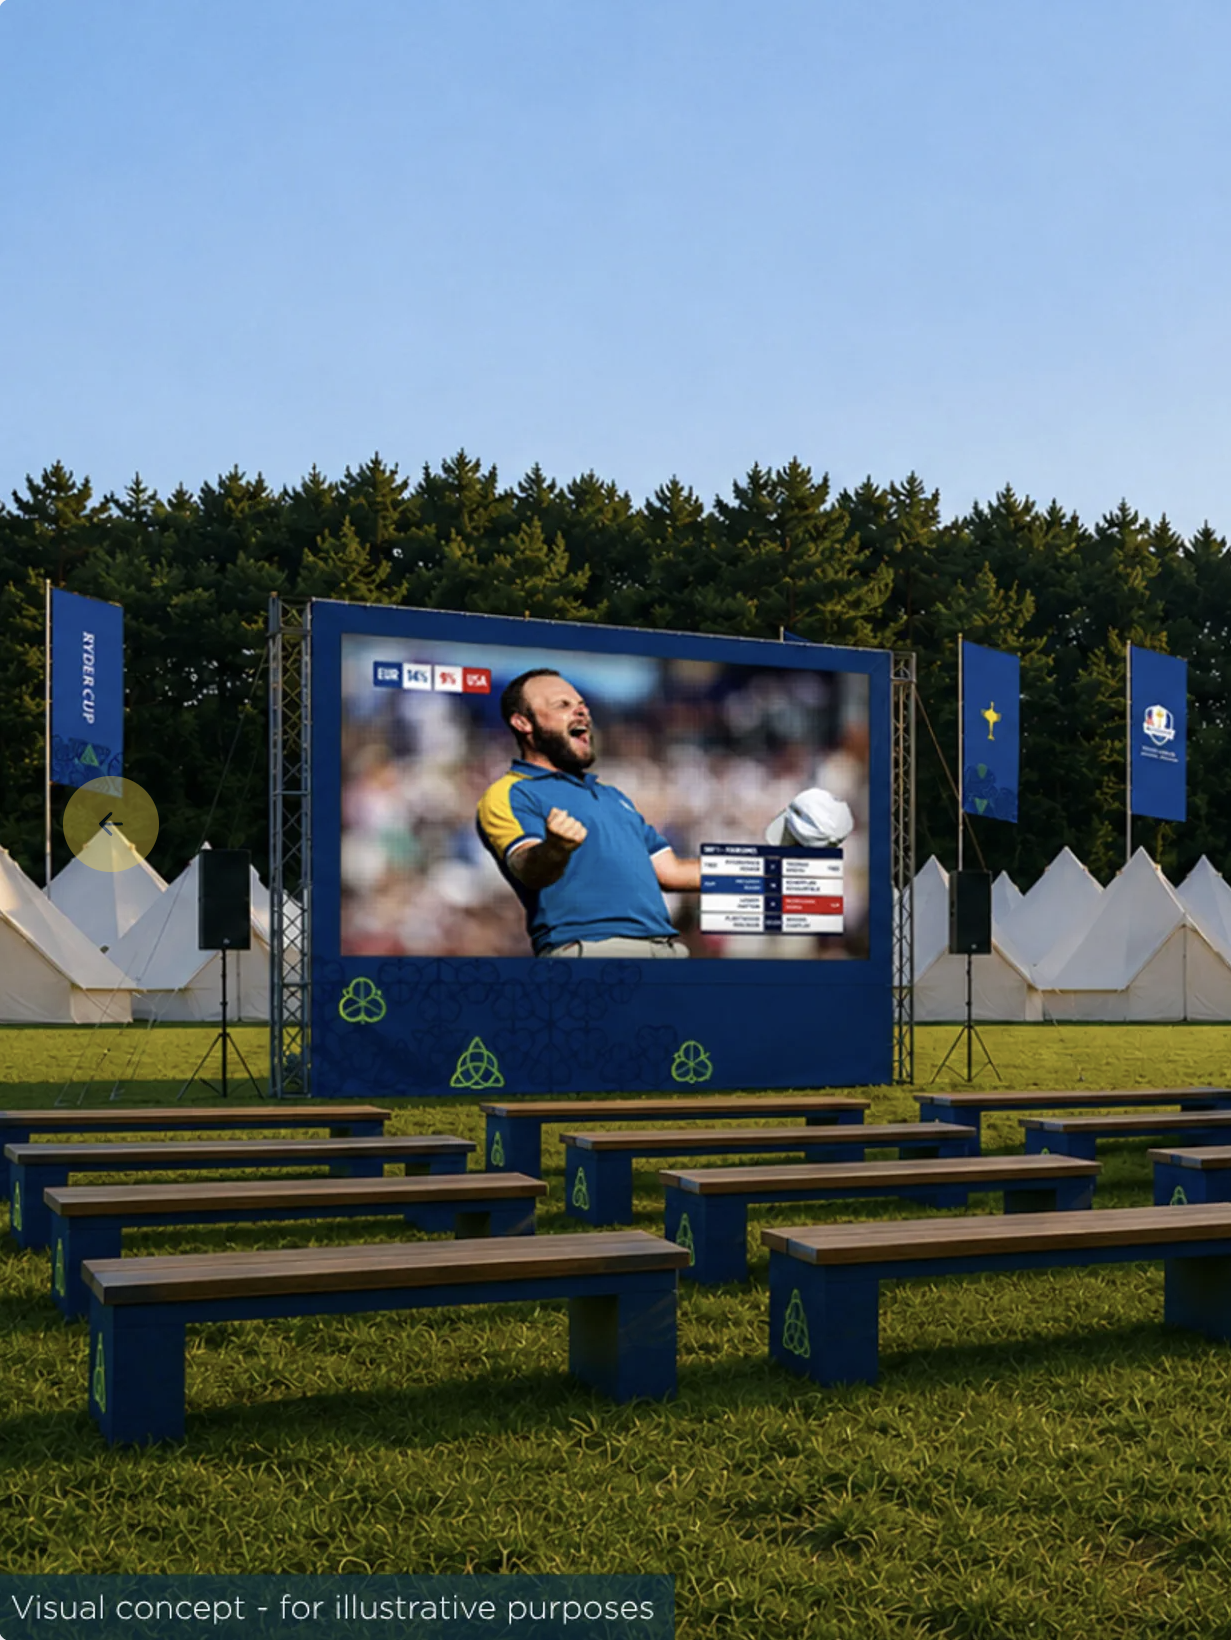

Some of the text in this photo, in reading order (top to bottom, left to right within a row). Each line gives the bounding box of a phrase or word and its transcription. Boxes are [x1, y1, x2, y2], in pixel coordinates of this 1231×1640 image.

[82, 631, 95, 724] RYDER CUP
[376, 667, 399, 680] EUR
[466, 673, 488, 687] USA
